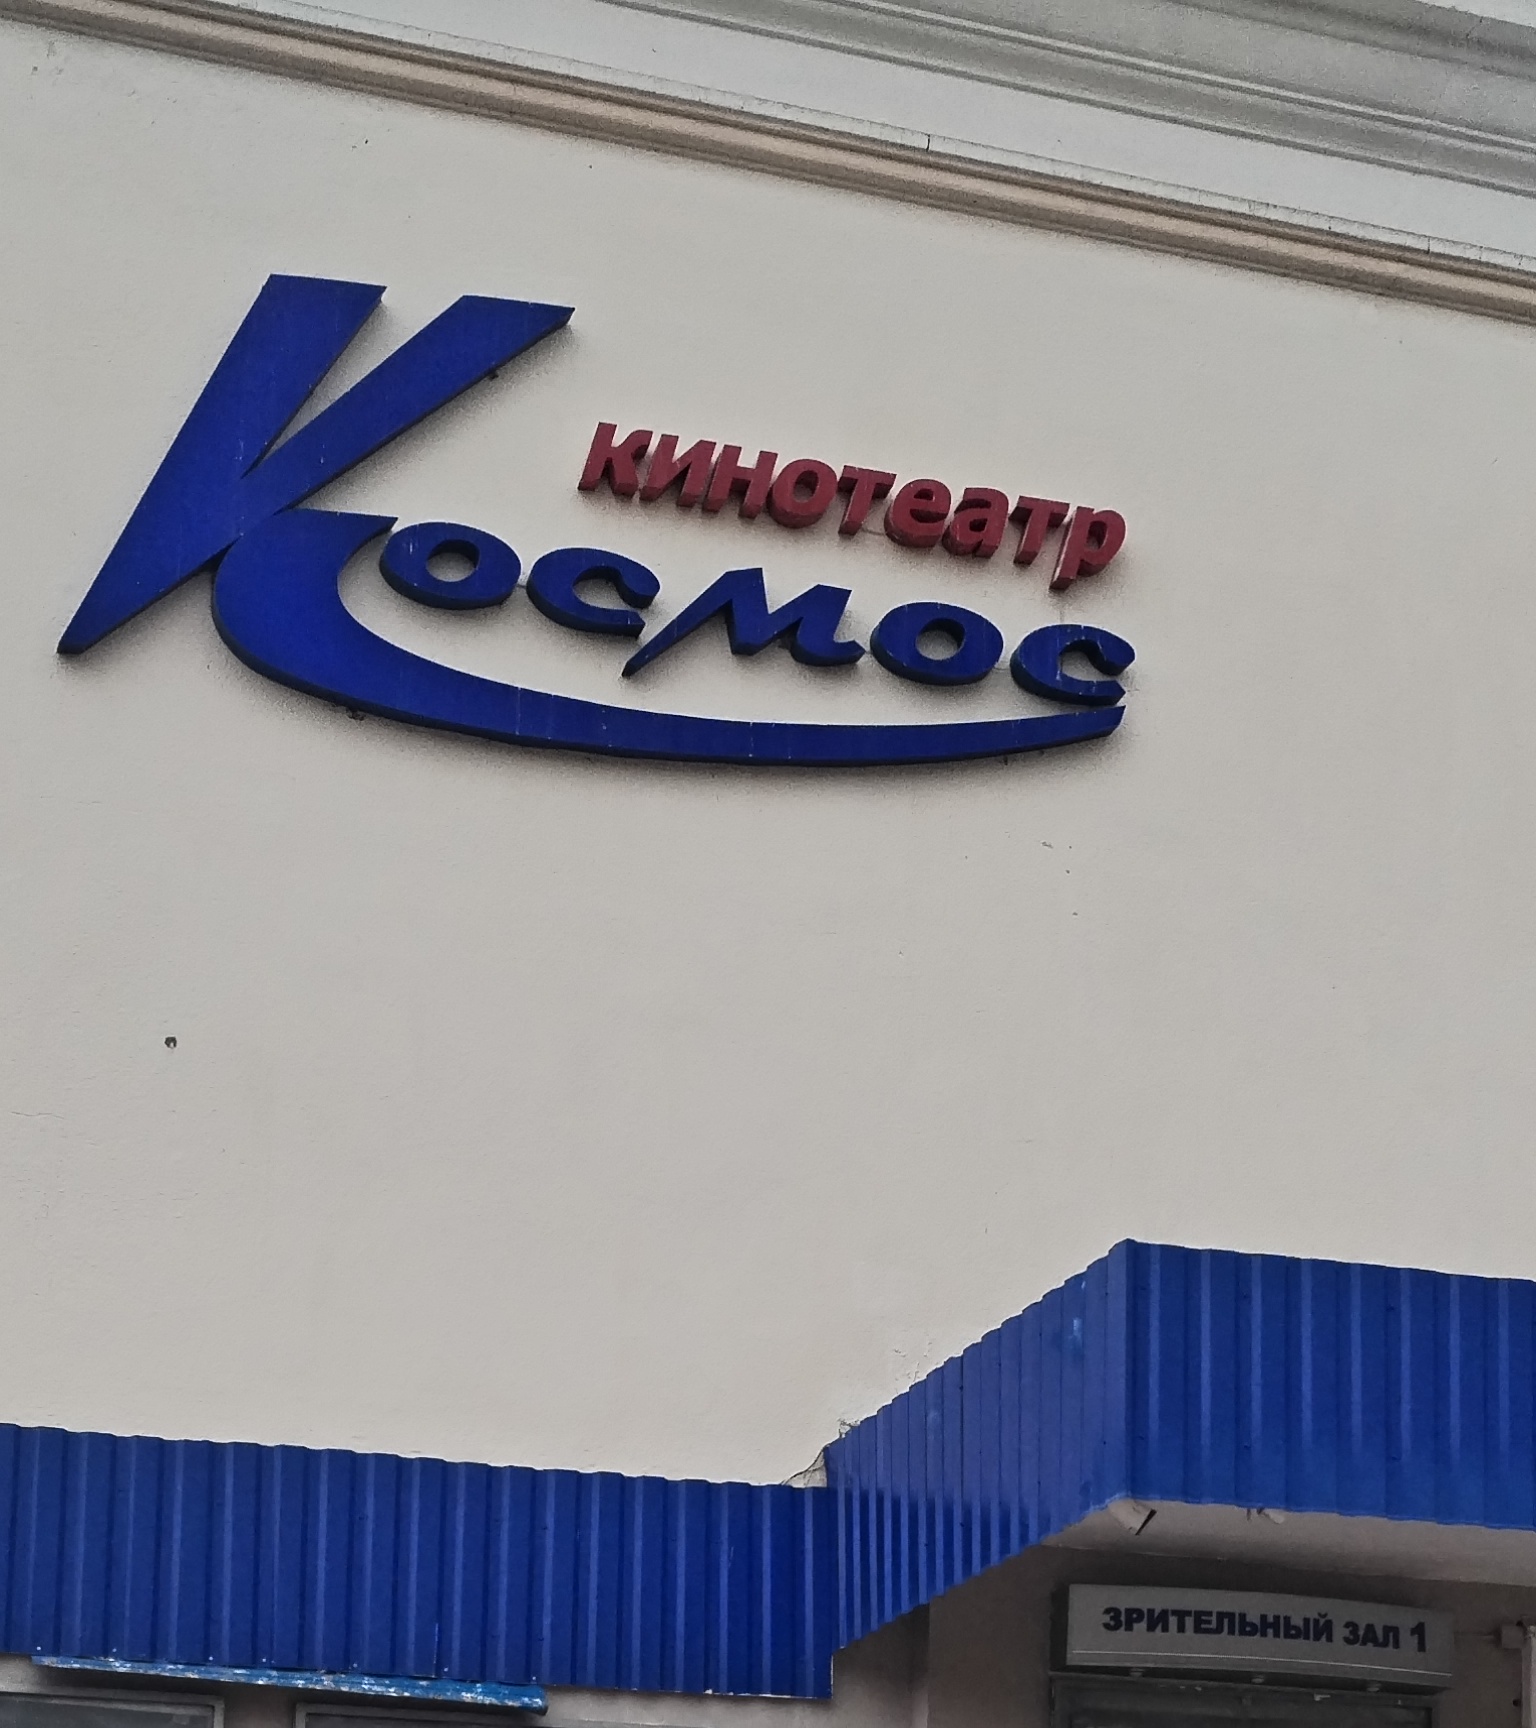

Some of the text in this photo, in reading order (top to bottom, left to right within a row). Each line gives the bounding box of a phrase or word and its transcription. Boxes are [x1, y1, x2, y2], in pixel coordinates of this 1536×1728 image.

[56, 273, 1136, 768] Космос
[1102, 1606, 1427, 1653] ЗРИТЕЛЬНЫЙ ЗАЛ 1
